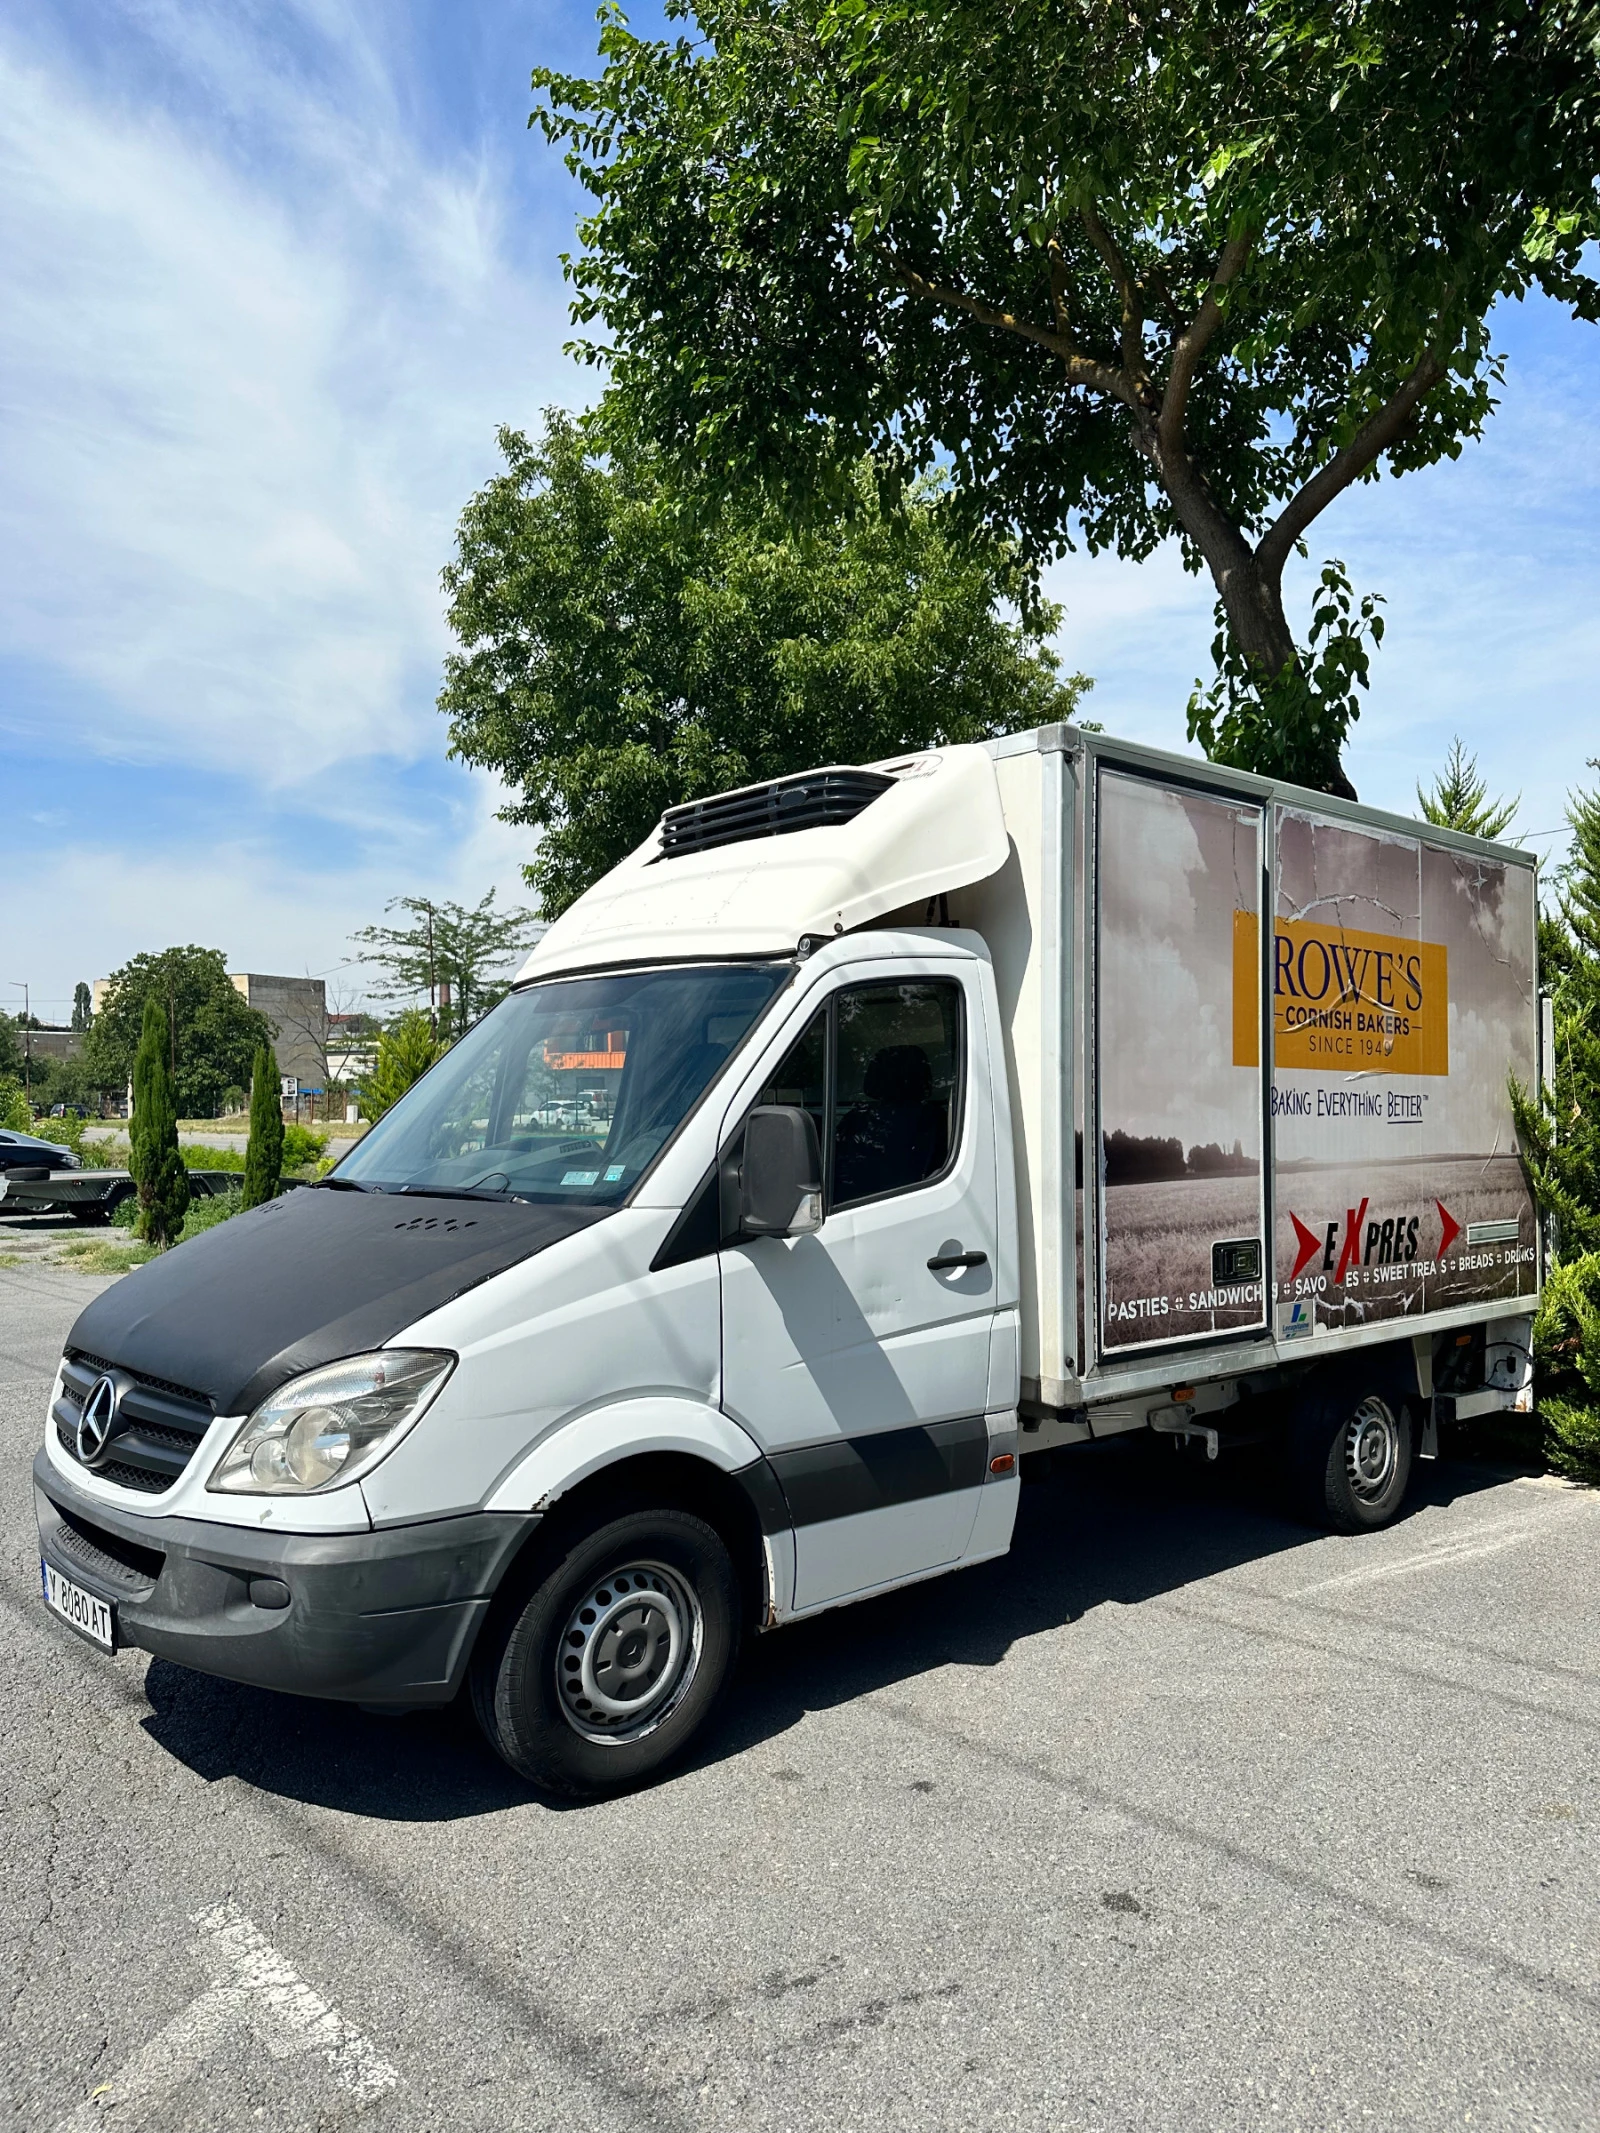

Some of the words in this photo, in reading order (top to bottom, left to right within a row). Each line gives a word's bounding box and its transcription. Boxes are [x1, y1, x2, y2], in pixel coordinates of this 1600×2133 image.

[1274, 935, 1422, 1011] ROWE'S
[1286, 1005, 1352, 1031] CORNISH
[1357, 1013, 1409, 1036] BAKERS
[1309, 1035, 1353, 1054] SINCE
[1360, 1039, 1393, 1057] 1949
[1108, 1296, 1169, 1322] PASTIES
[1189, 1282, 1278, 1311] SANDWICHS
[1373, 1264, 1408, 1284] SWEET
[1411, 1259, 1447, 1278] TREAS
[1459, 1252, 1494, 1271] BREADS
[62, 1581, 89, 1626] 8080
[92, 1601, 108, 1638] AT
